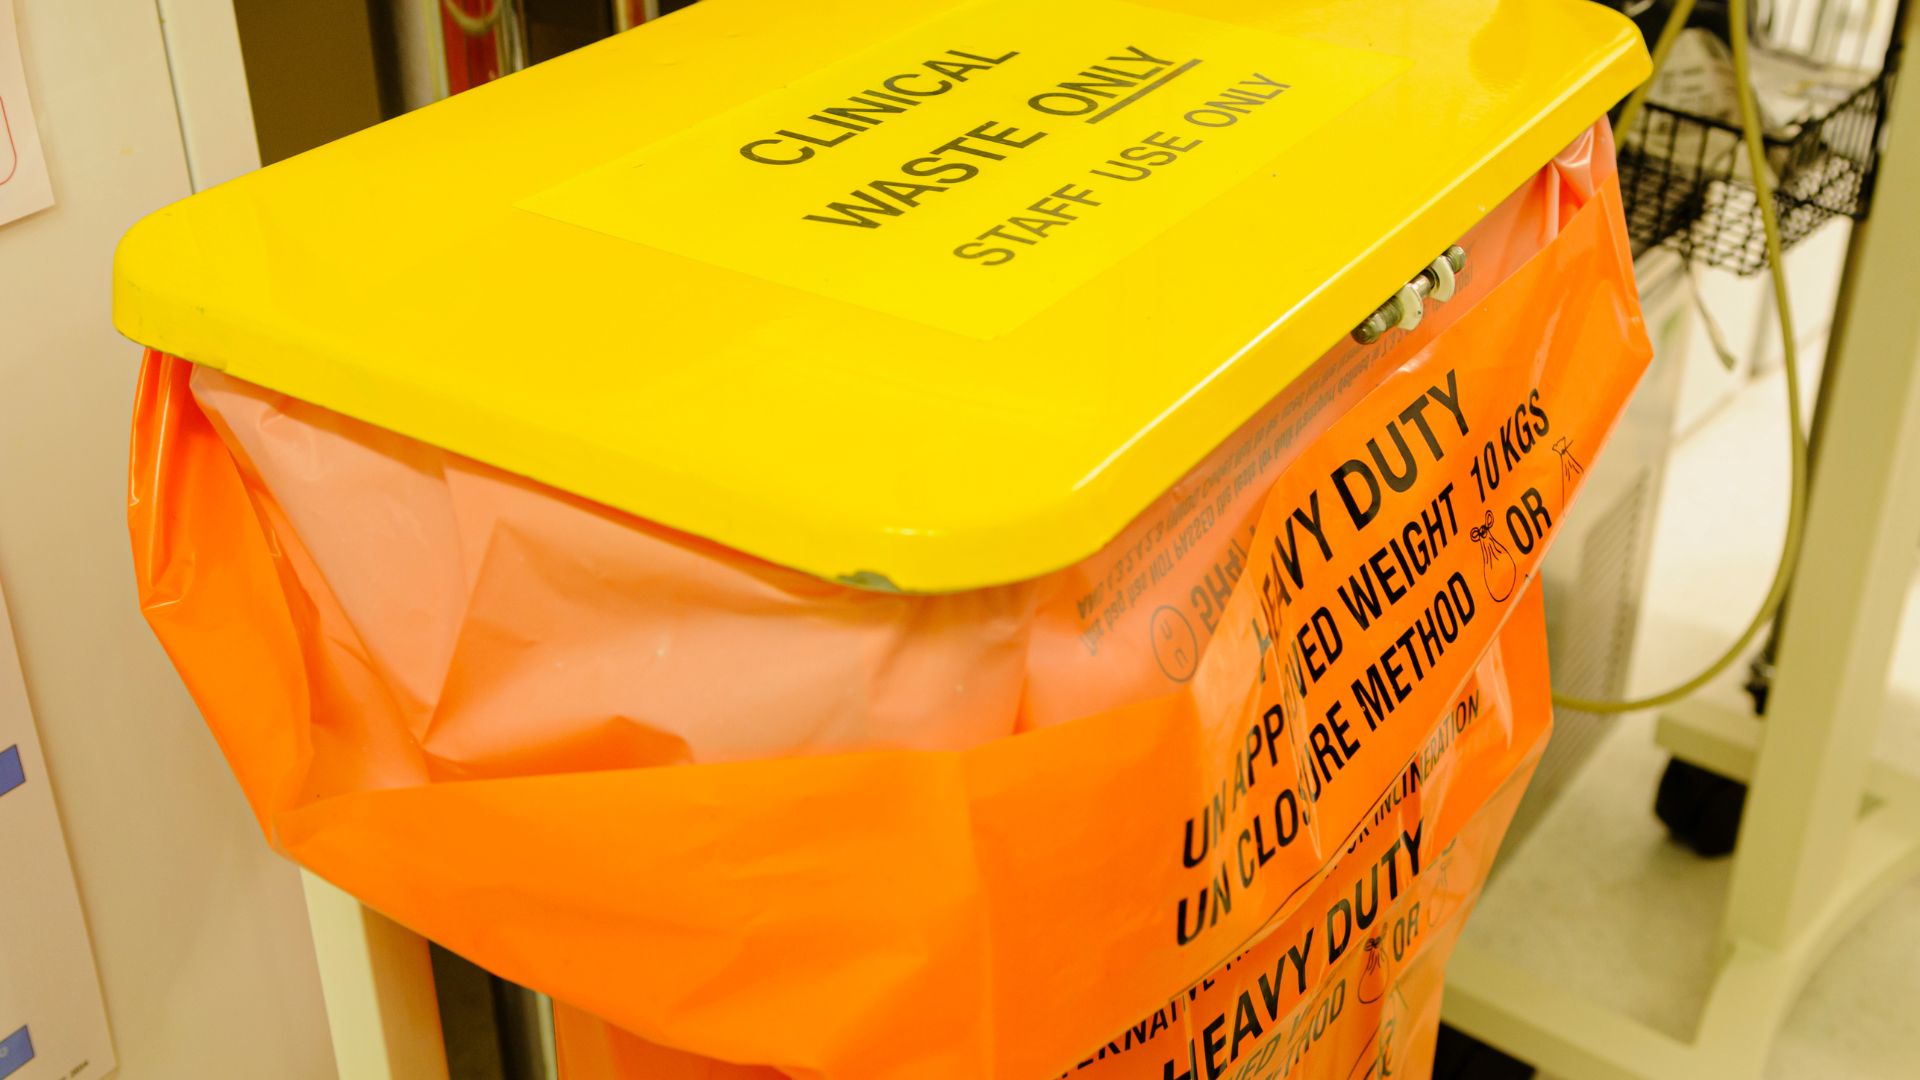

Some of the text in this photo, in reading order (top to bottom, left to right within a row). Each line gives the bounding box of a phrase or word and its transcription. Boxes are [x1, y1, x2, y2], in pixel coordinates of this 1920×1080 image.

[739, 46, 1021, 166] CLINICAL
[802, 45, 1176, 230] WASTE ONLY
[953, 72, 1293, 268] STAFF USE ONLY
[1331, 370, 1470, 531] DUTY
[1183, 388, 1550, 869] UN APPOVED WEIGHT 10 KGS
[1177, 862, 1231, 947] UN
[1351, 571, 1475, 732] METHOD
[1506, 487, 1552, 556] OR
[1327, 816, 1424, 965] DUTY
[1393, 901, 1421, 962] OR
